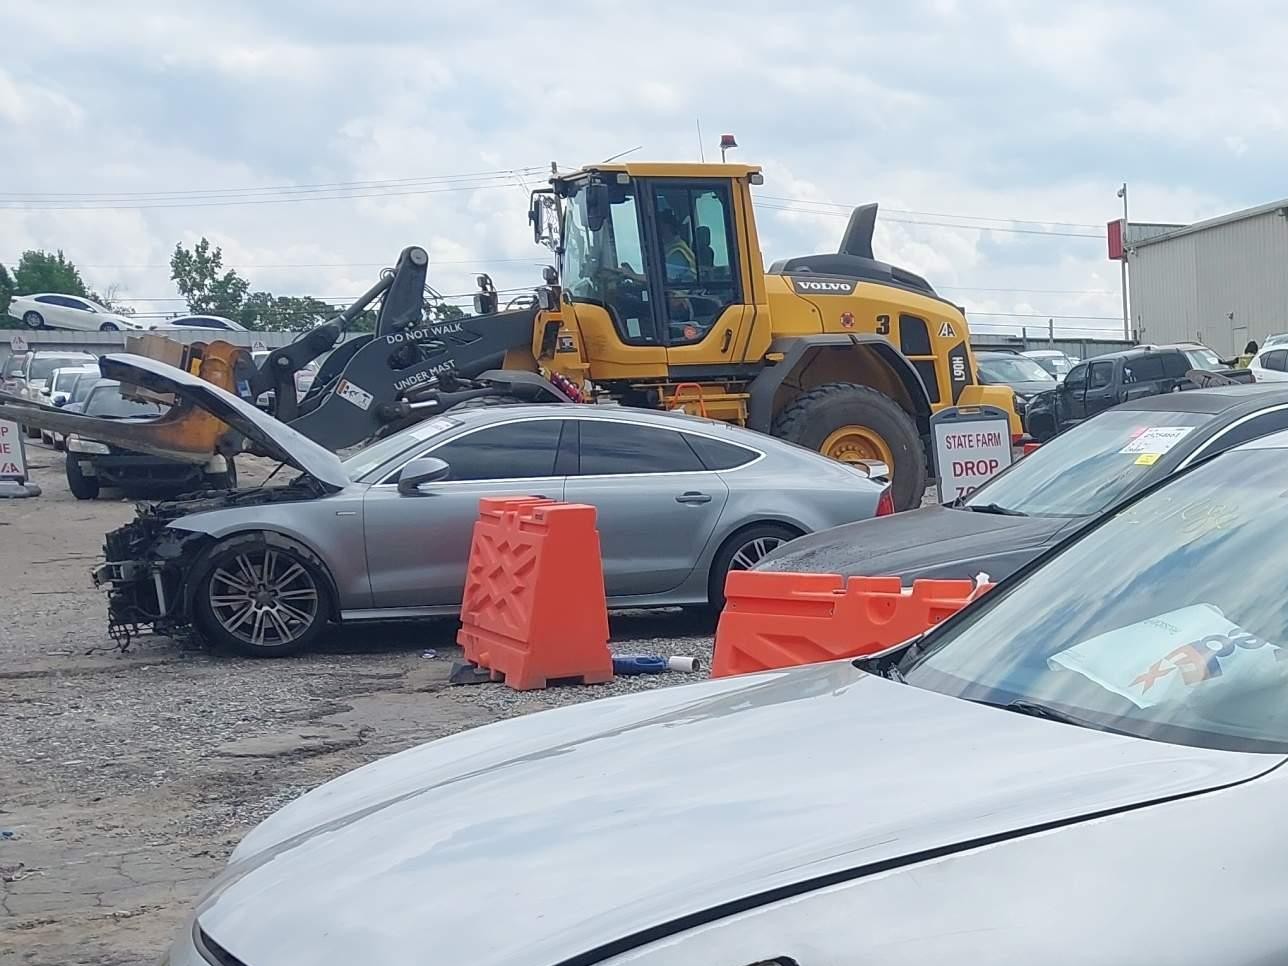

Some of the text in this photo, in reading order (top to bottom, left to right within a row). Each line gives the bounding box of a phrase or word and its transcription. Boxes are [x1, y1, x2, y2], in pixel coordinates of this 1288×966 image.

[797, 282, 851, 291] VOLVO
[386, 323, 463, 344] DO NOT WALK
[876, 315, 890, 335] 3
[394, 359, 456, 391] UNDER MAST
[952, 356, 966, 381] L90H
[945, 432, 1001, 449] STATE FARM
[952, 459, 999, 478] DROP
